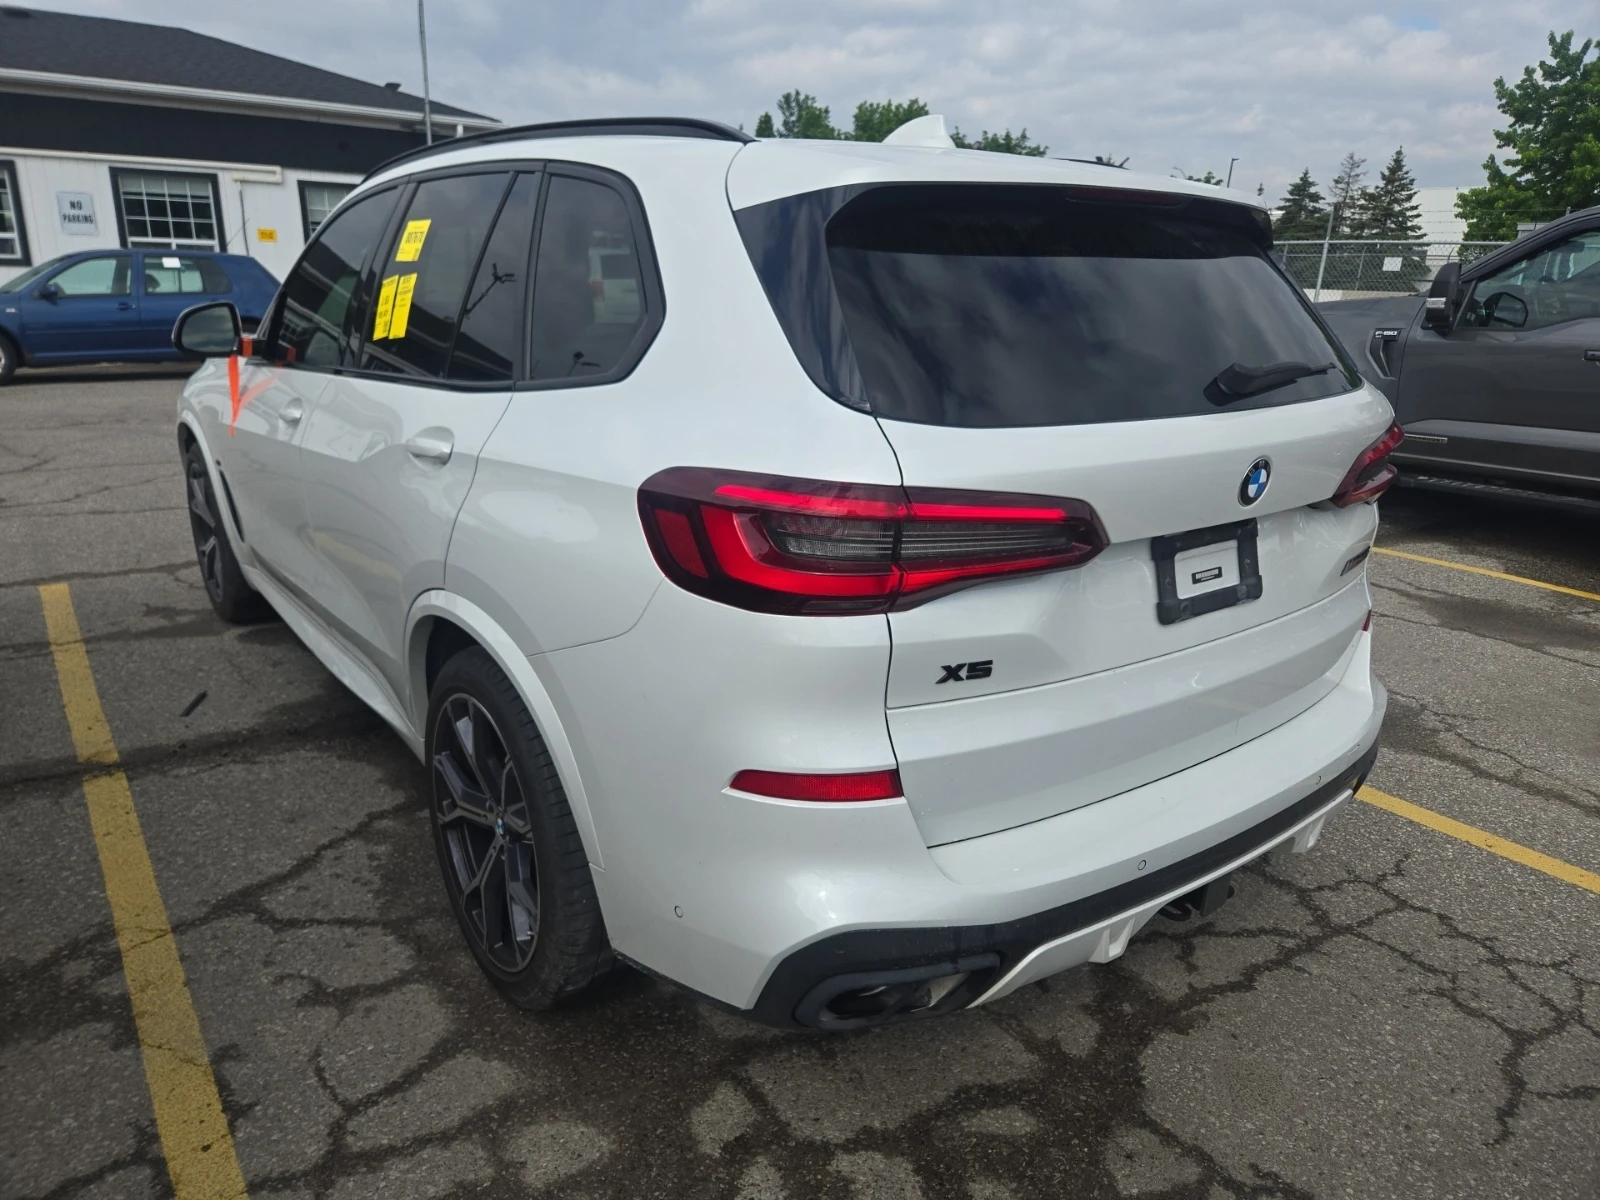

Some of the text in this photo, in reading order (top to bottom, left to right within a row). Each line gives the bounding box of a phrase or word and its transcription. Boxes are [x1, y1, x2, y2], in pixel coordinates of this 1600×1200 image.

[69, 200, 82, 211] NO
[62, 213, 93, 224] PARKING
[935, 659, 993, 684] X5
